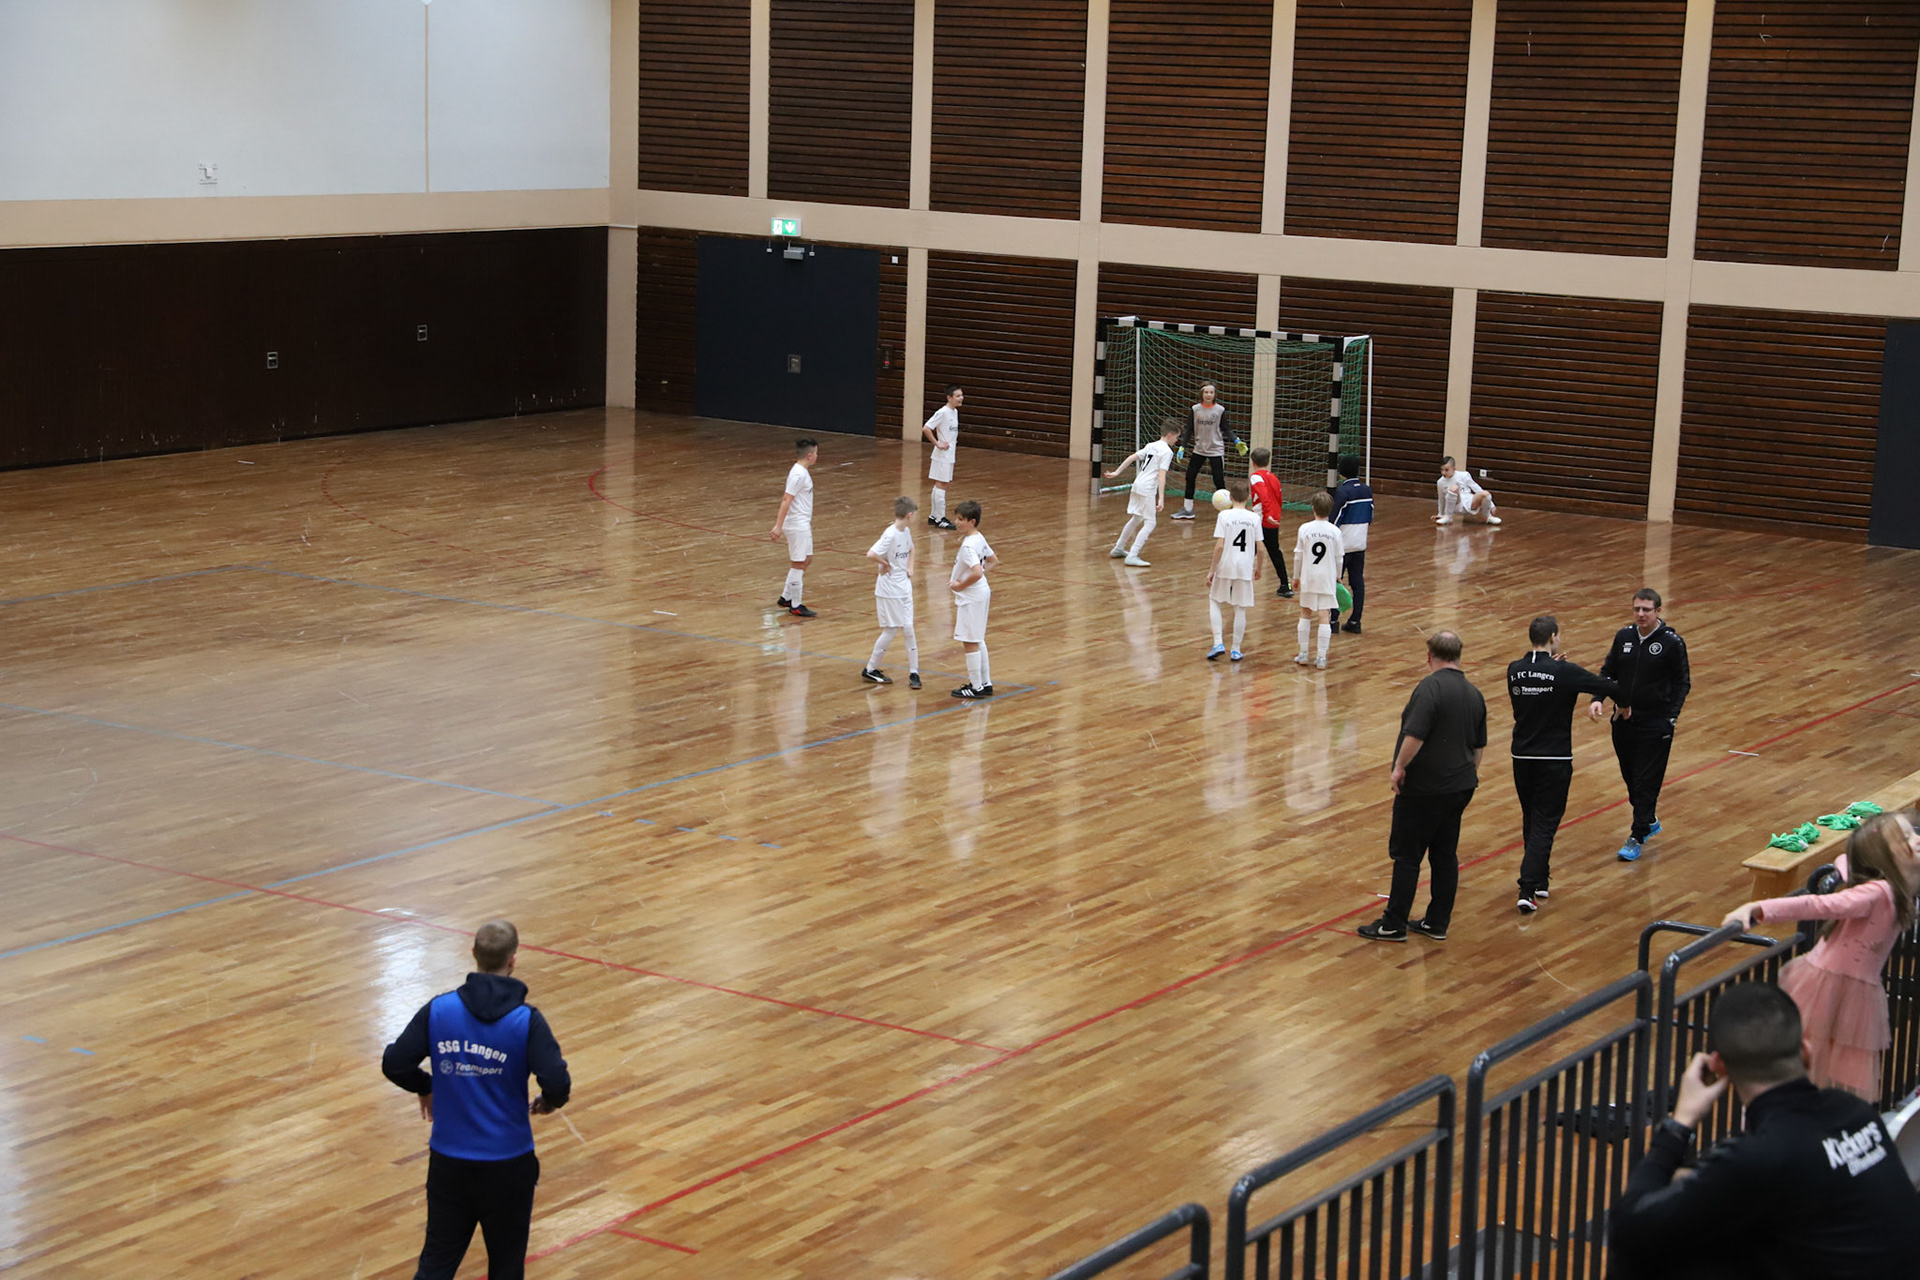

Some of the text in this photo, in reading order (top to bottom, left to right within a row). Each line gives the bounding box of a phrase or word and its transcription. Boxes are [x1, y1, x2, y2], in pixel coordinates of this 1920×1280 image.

[1232, 529, 1247, 552] 4
[1311, 541, 1327, 564] 9
[1517, 671, 1527, 679] FC
[1528, 671, 1555, 681] Langen
[437, 1040, 508, 1063] SSG Langen
[455, 1062, 504, 1075] Teamsport
